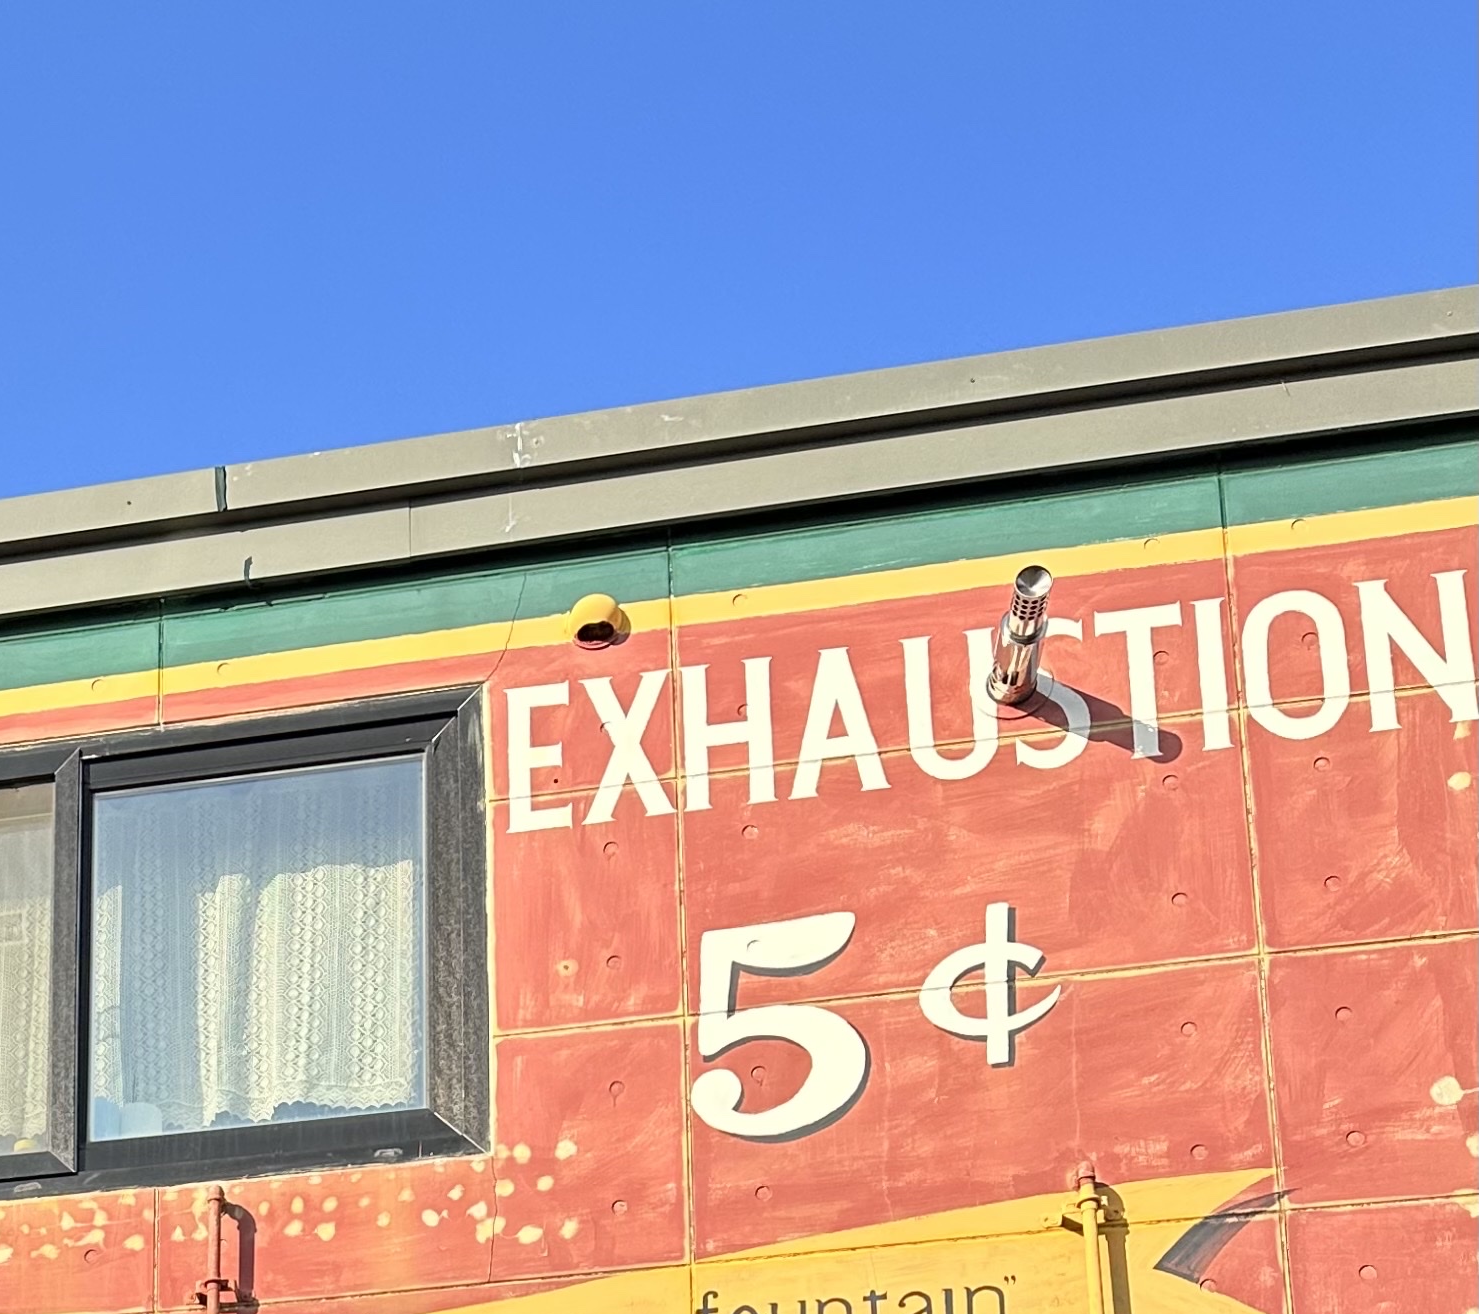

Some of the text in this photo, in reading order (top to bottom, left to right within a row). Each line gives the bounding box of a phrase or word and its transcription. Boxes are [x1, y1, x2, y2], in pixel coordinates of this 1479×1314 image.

[505, 569, 1479, 836] EXHAUSTION
[690, 902, 1062, 1138] 5 ¢
